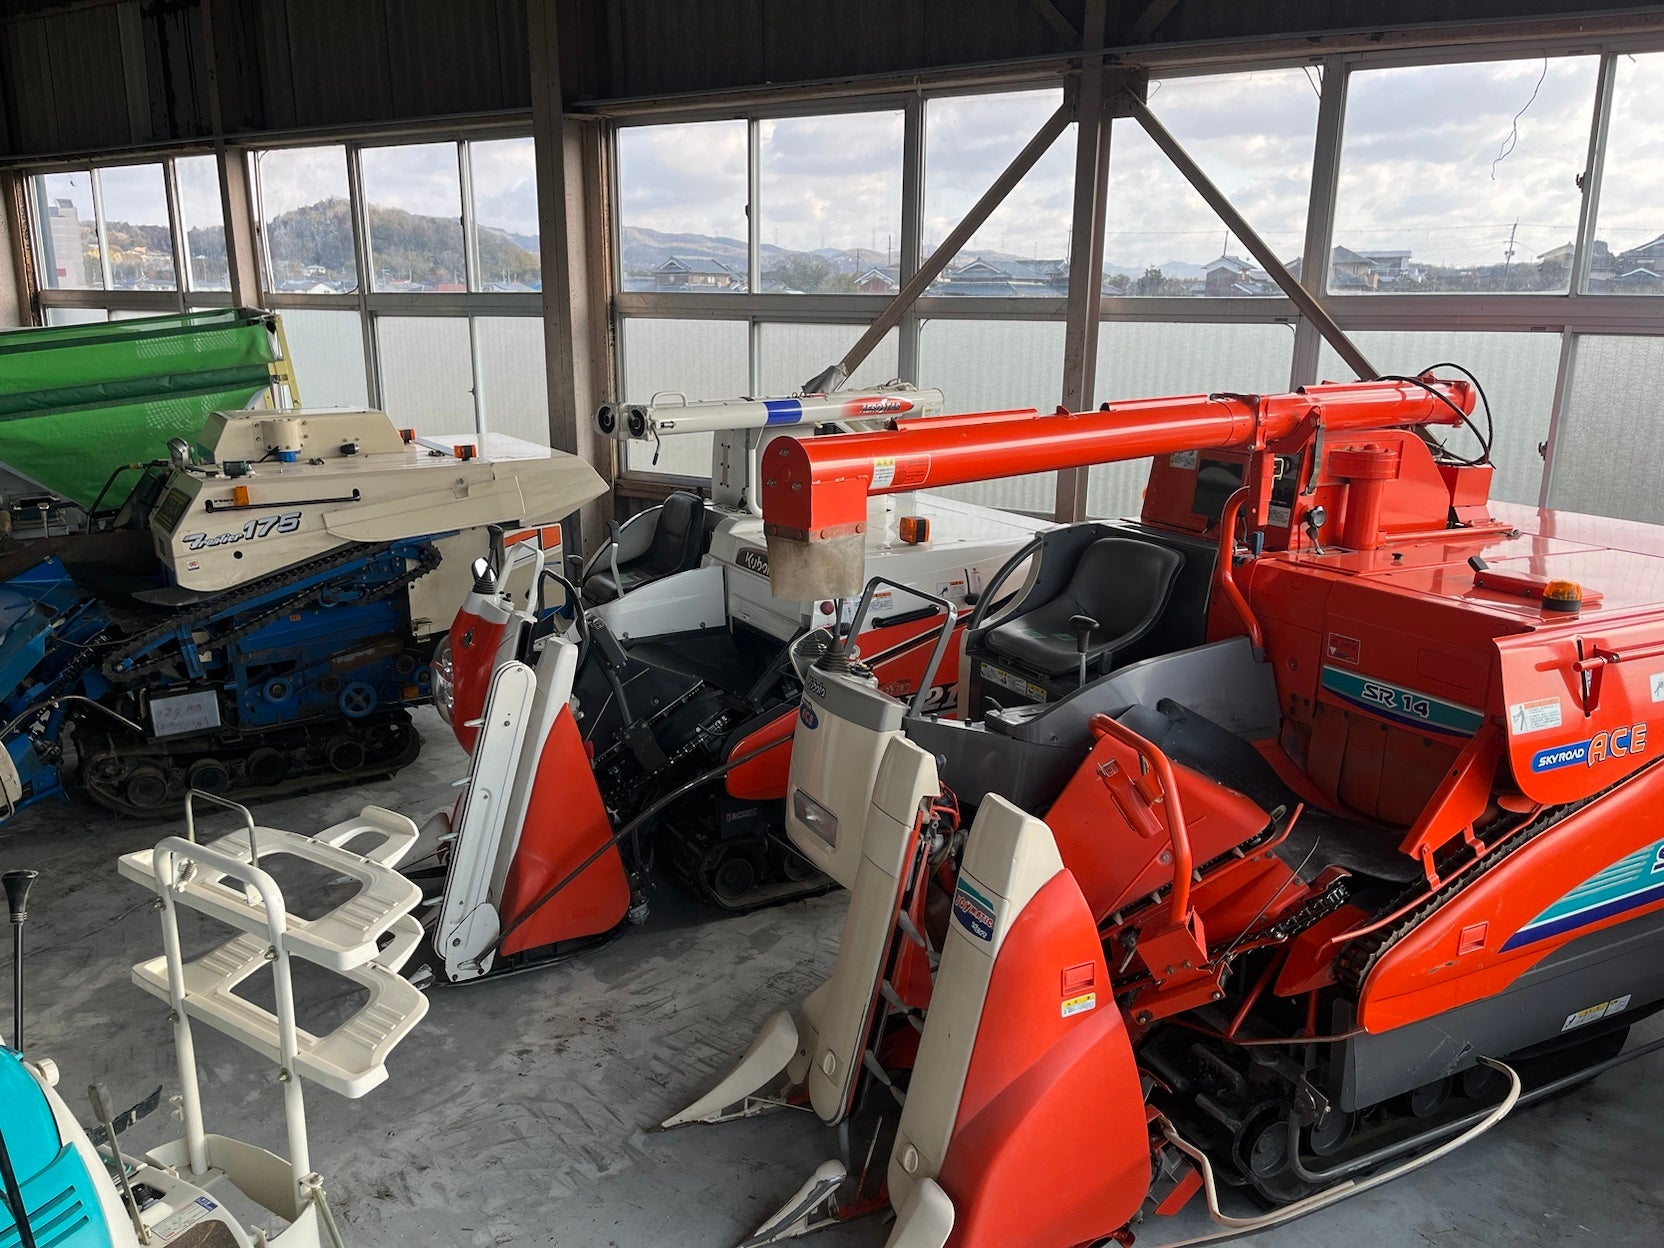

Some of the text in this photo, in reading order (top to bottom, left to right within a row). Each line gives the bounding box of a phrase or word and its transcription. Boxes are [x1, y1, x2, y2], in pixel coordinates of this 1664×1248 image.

[243, 511, 302, 540] 175
[744, 551, 770, 575] Kubo
[1361, 682, 1430, 719] SR 14
[1537, 722, 1647, 768] SKYROAD ACE
